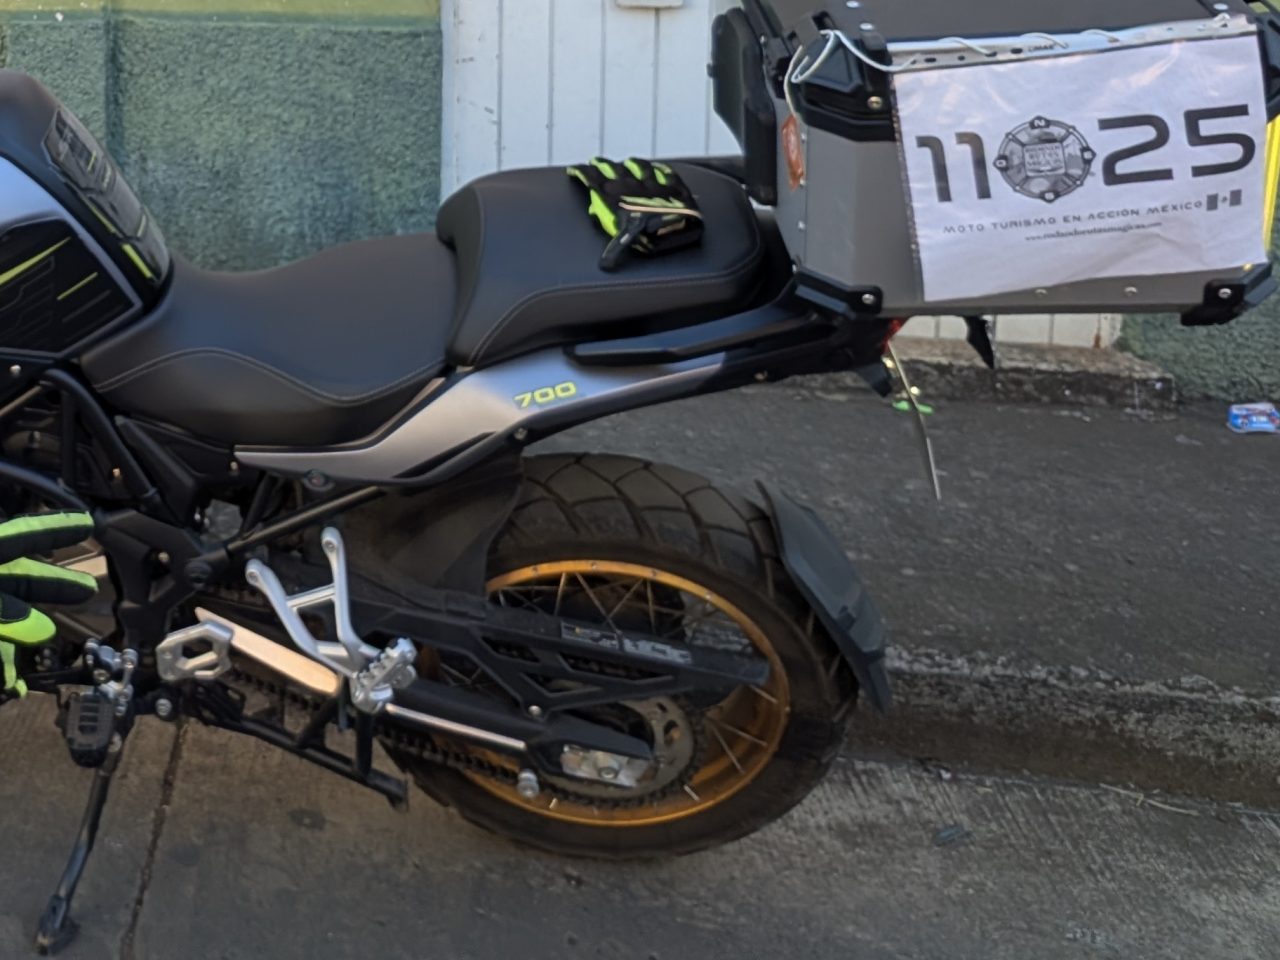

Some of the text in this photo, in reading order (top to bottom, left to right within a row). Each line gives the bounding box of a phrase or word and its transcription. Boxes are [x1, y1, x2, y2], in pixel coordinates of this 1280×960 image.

[943, 223, 985, 234] MOTO
[990, 217, 1057, 230] TURISMO
[1062, 214, 1082, 224] EN
[513, 381, 577, 409] 700
